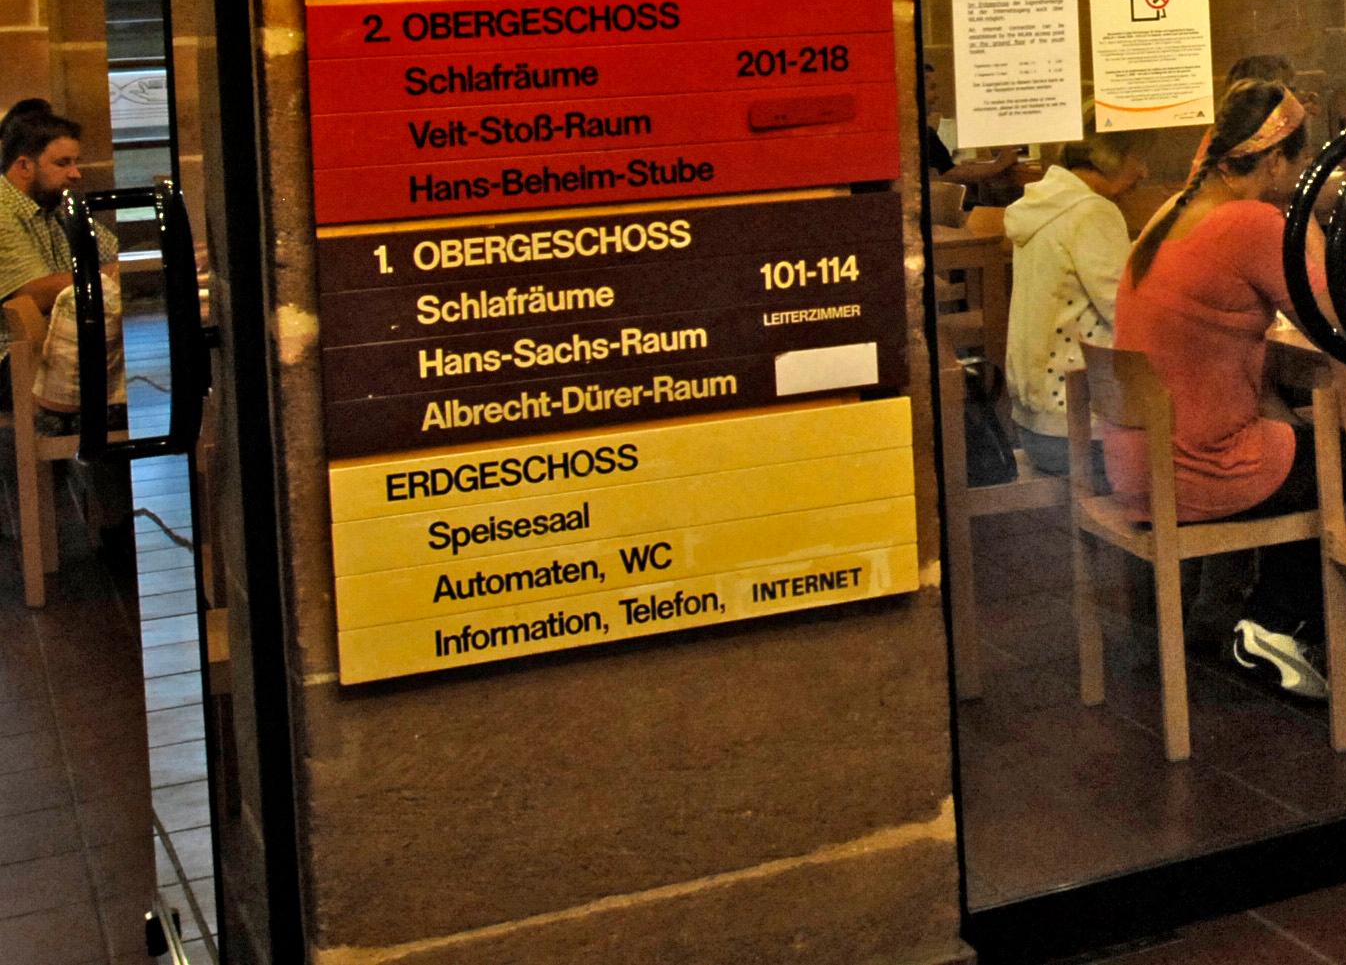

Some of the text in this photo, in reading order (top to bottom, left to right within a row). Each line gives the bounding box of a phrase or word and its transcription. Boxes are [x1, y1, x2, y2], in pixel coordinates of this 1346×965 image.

[363, 1, 680, 43] 2. OBERGESCHOSS
[405, 46, 849, 97] Schlafräume 201-218
[408, 110, 651, 149] Veit-Stoß-Raum
[409, 159, 714, 203] Hans-Beheim-Stube
[373, 220, 691, 275] 1. OBERGESCHOSS
[416, 256, 859, 326] Schlafräume 101-114
[763, 304, 861, 327] LEITERZIMMER
[419, 326, 707, 378] Hans-Sachs-Raum
[421, 372, 737, 431] Albrecht-Dürer-Raum
[386, 443, 639, 502] ERDGESCHOSS
[428, 502, 590, 555] Speisesaal
[432, 542, 673, 603] Automaten, WC
[435, 569, 862, 657] Information, Telefon, INTERNET
